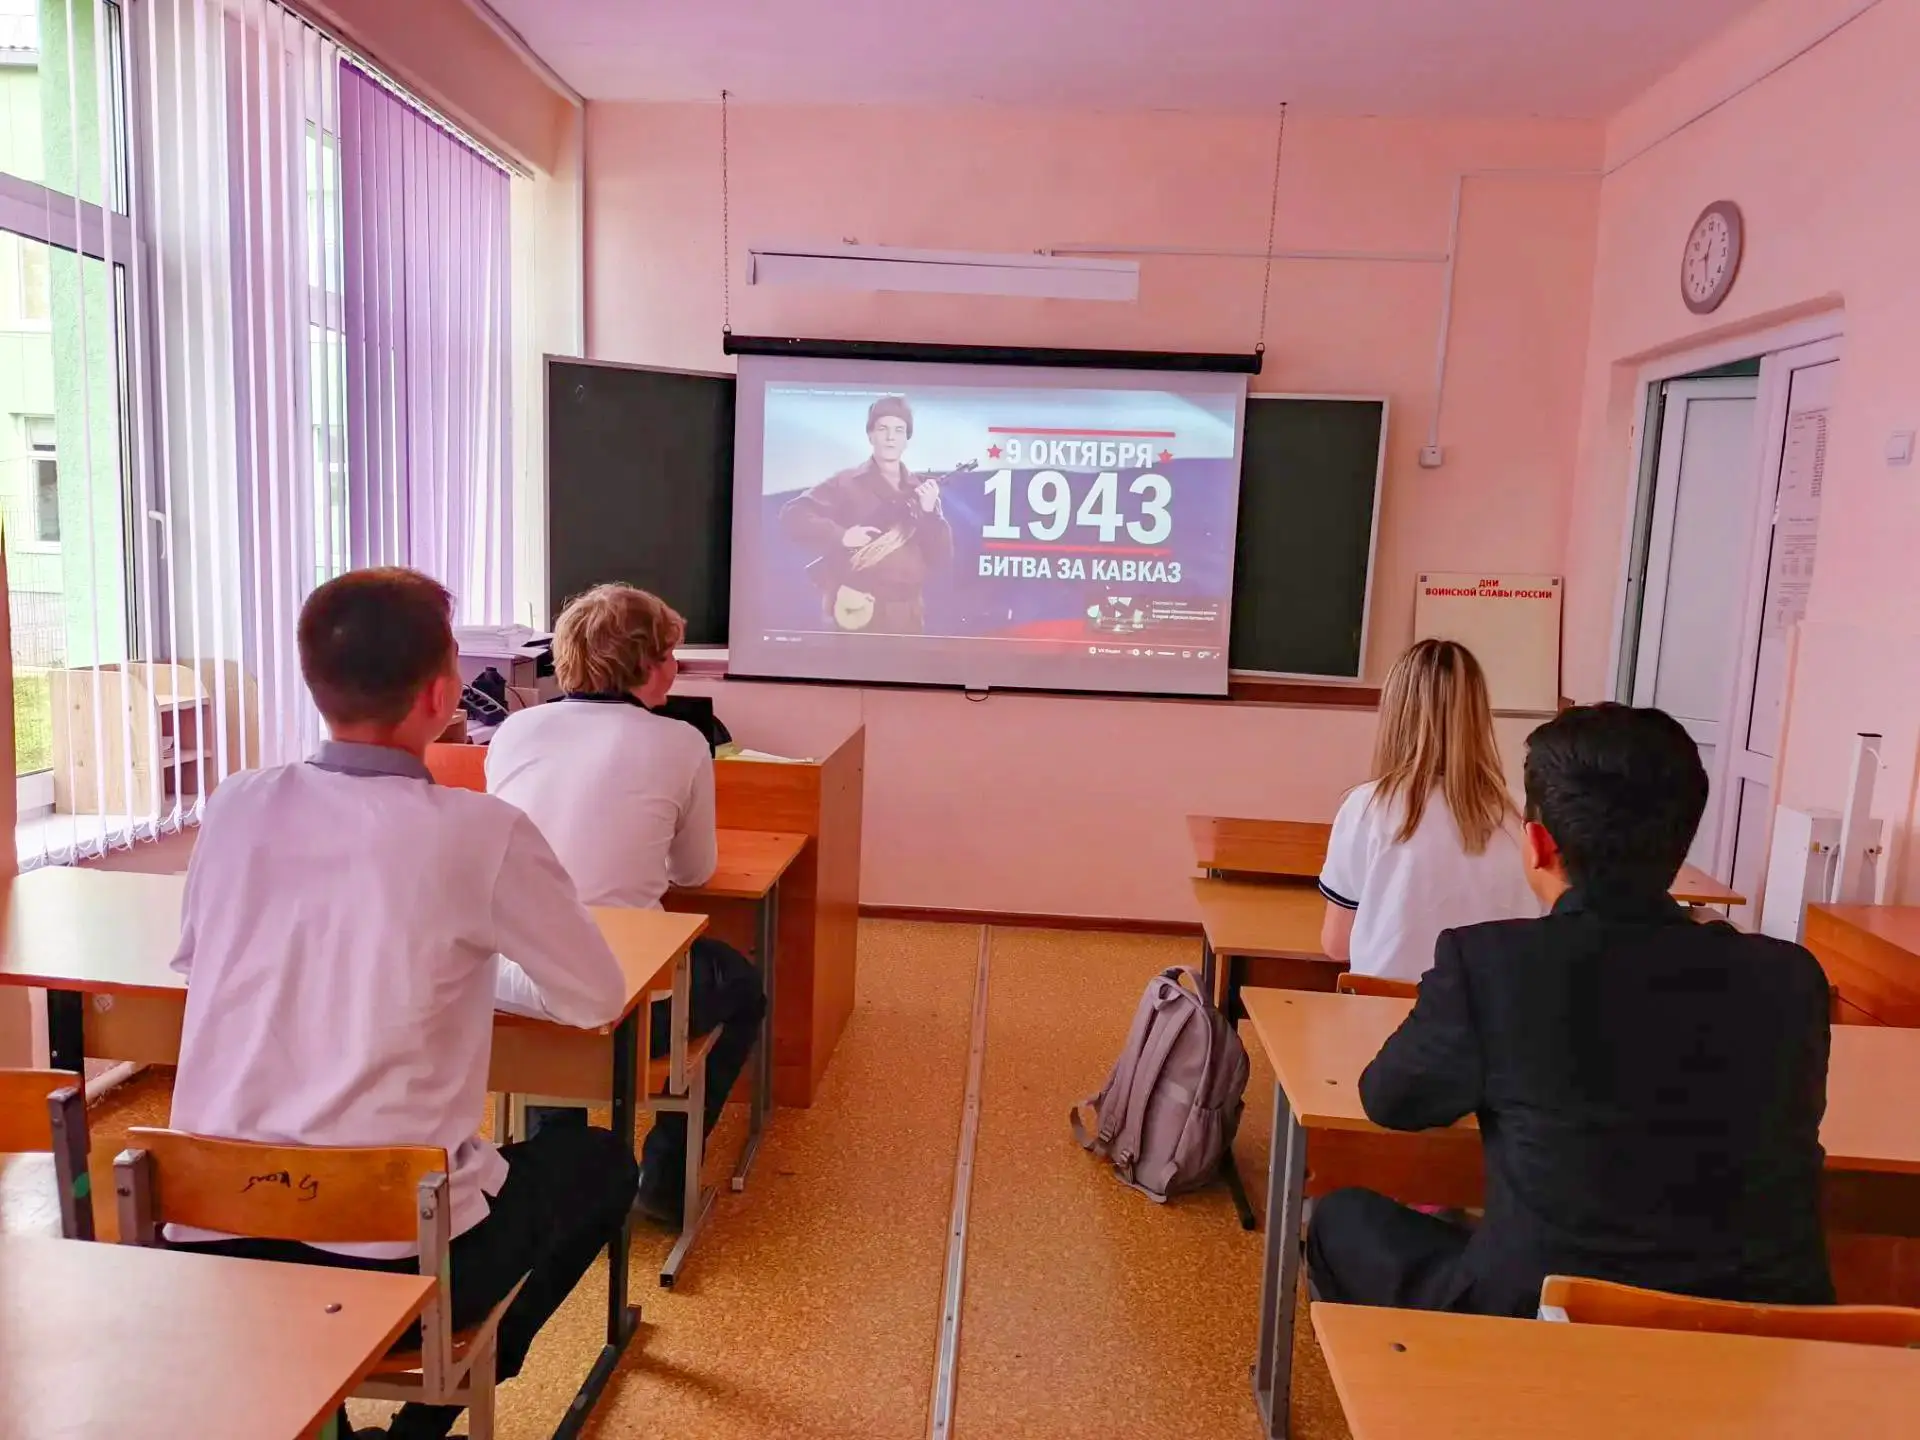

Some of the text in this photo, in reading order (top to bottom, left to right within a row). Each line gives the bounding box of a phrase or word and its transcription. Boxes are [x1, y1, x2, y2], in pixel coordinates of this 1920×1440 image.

[1006, 439, 1153, 468] 9 ОКТЯБРЯ
[982, 469, 1172, 544] 1943
[978, 555, 1182, 583] БИТВА ЗА КАВКАЗ
[1425, 587, 1552, 599] ВОИНСКОЙ СЛАВЫ РОССИИ
[1478, 579, 1499, 588] ДНИ
